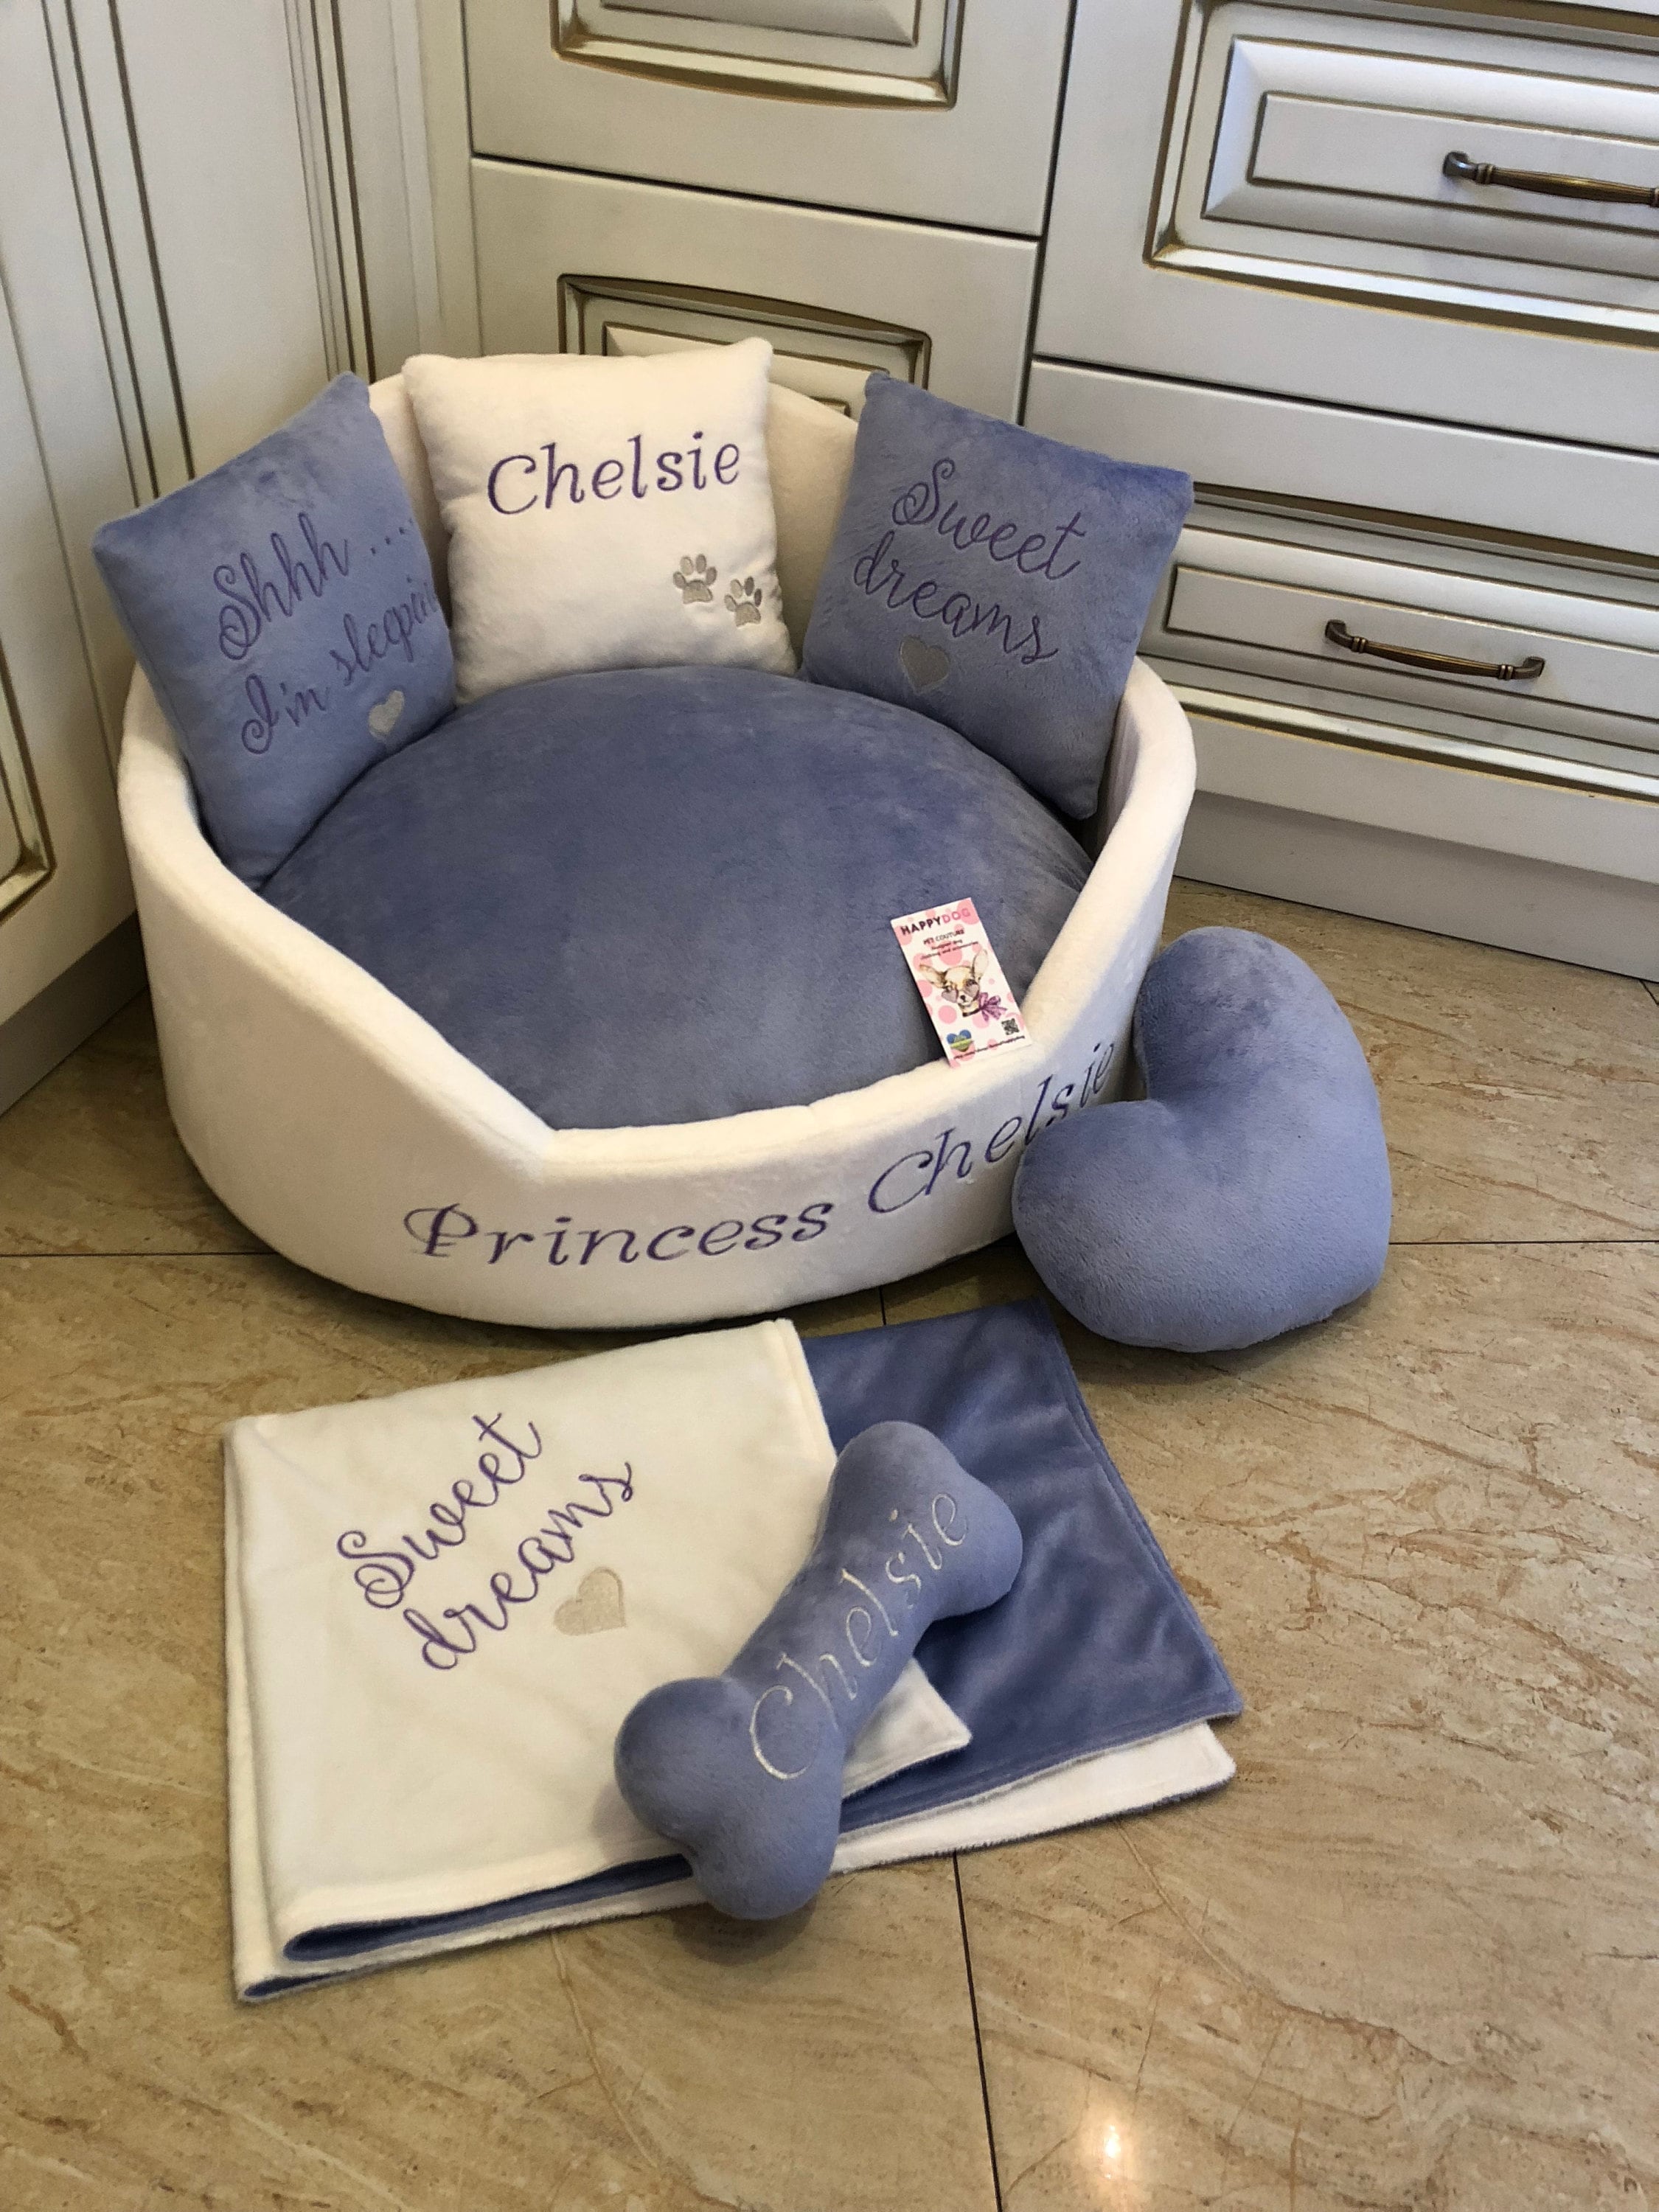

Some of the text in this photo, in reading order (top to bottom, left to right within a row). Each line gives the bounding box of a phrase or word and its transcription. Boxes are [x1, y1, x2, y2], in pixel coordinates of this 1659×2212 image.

[487, 431, 740, 515] Chelsie
[891, 457, 1085, 580] Sweet
[213, 512, 349, 661] Shhh
[853, 530, 1059, 664] dreams
[241, 673, 331, 755] I'm
[900, 907, 971, 936] HAPPYDOG
[403, 1041, 1116, 1265] Princess Chelsie
[336, 1412, 542, 1609] Sweet
[403, 1461, 634, 1671] dreams
[749, 1492, 969, 1781] Chelsie
